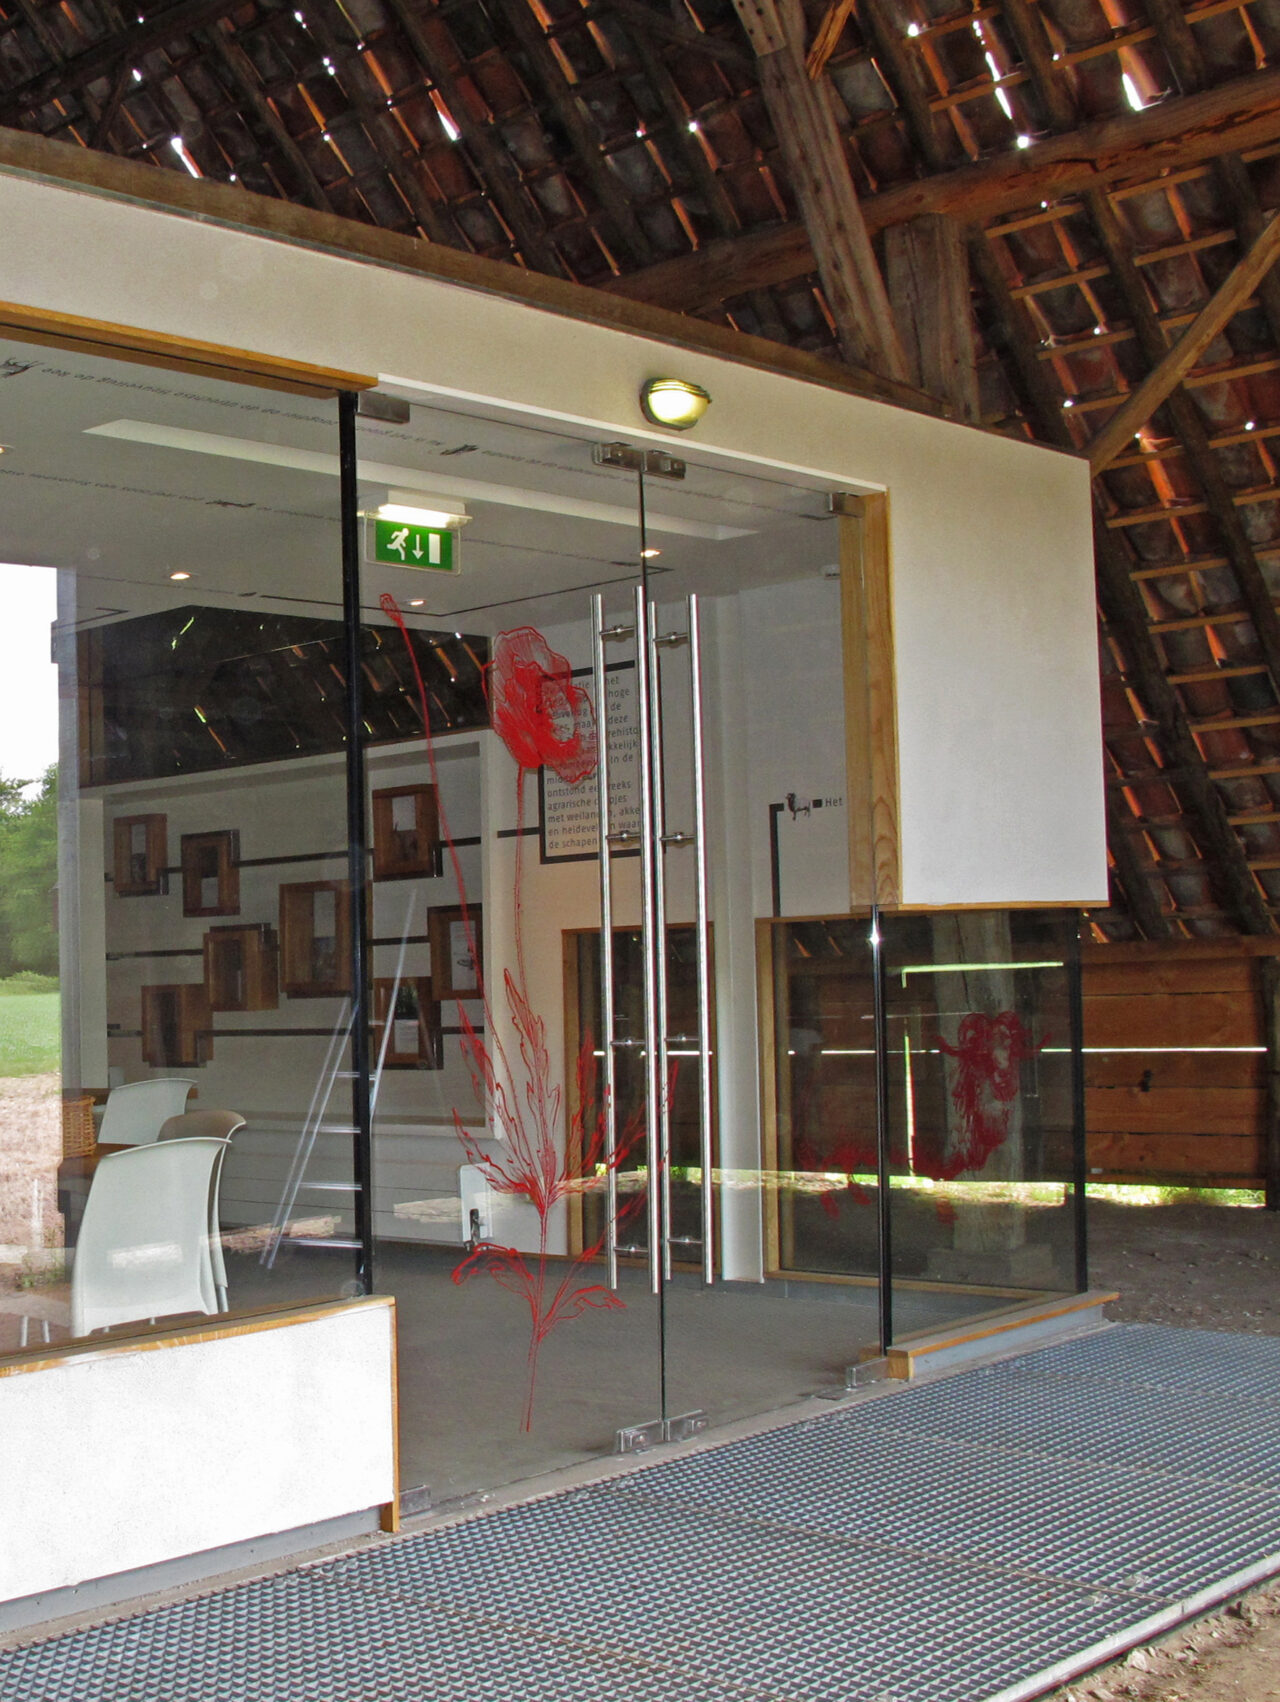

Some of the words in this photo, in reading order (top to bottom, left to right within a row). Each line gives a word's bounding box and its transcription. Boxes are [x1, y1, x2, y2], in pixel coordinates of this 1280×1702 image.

[608, 688, 630, 699] hoge
[610, 702, 622, 711] de
[608, 713, 628, 725] deze
[548, 799, 591, 812] agrarische
[825, 797, 843, 807] Het
[548, 814, 565, 823] met
[548, 829, 559, 837] en
[549, 840, 560, 849] de
[562, 838, 597, 848] schapen
